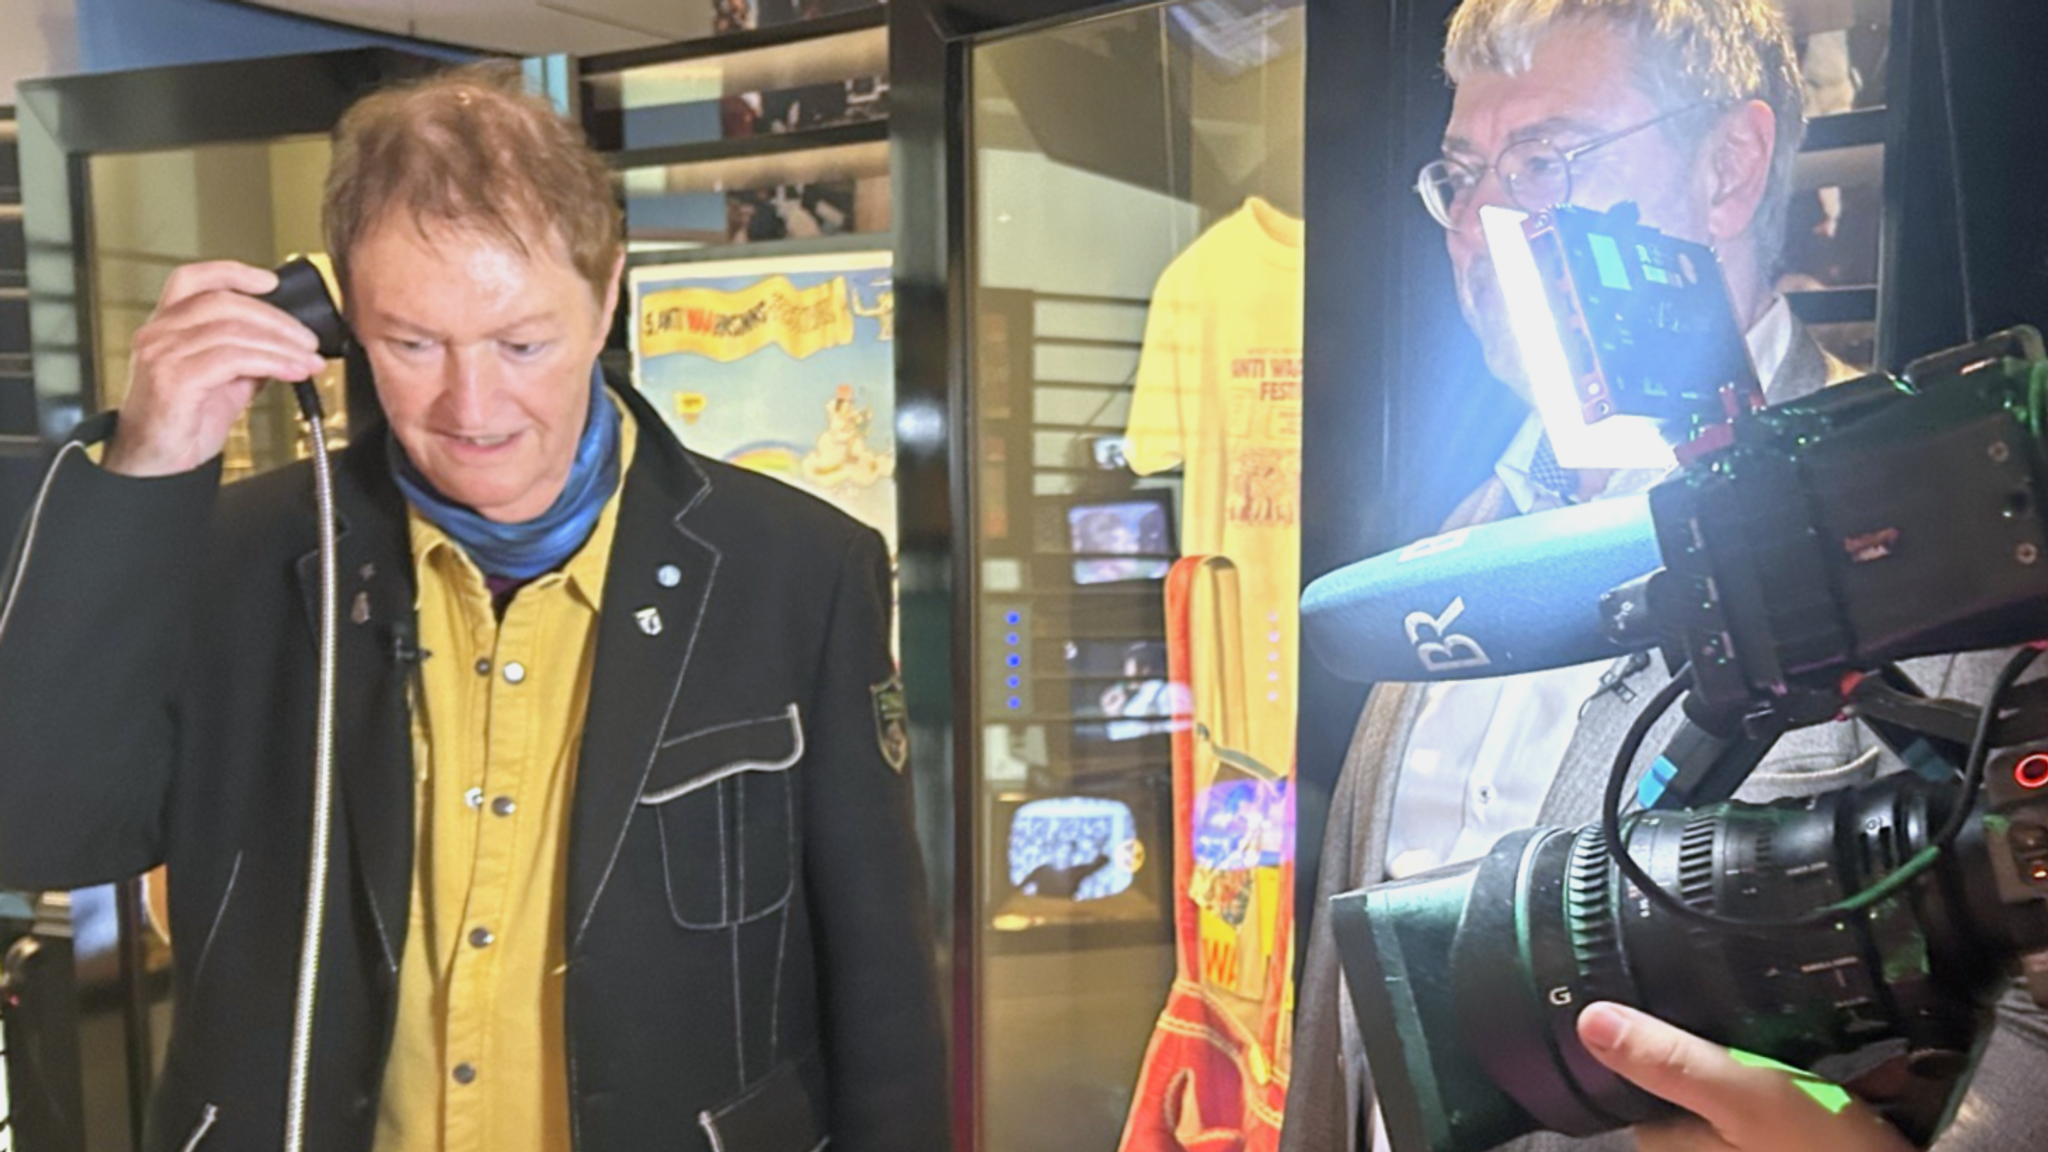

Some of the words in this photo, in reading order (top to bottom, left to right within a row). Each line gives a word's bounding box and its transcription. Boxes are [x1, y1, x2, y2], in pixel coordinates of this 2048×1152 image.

[1231, 358, 1266, 378] ANTI
[1404, 596, 1491, 672] BR
[1549, 986, 1572, 1005] G
